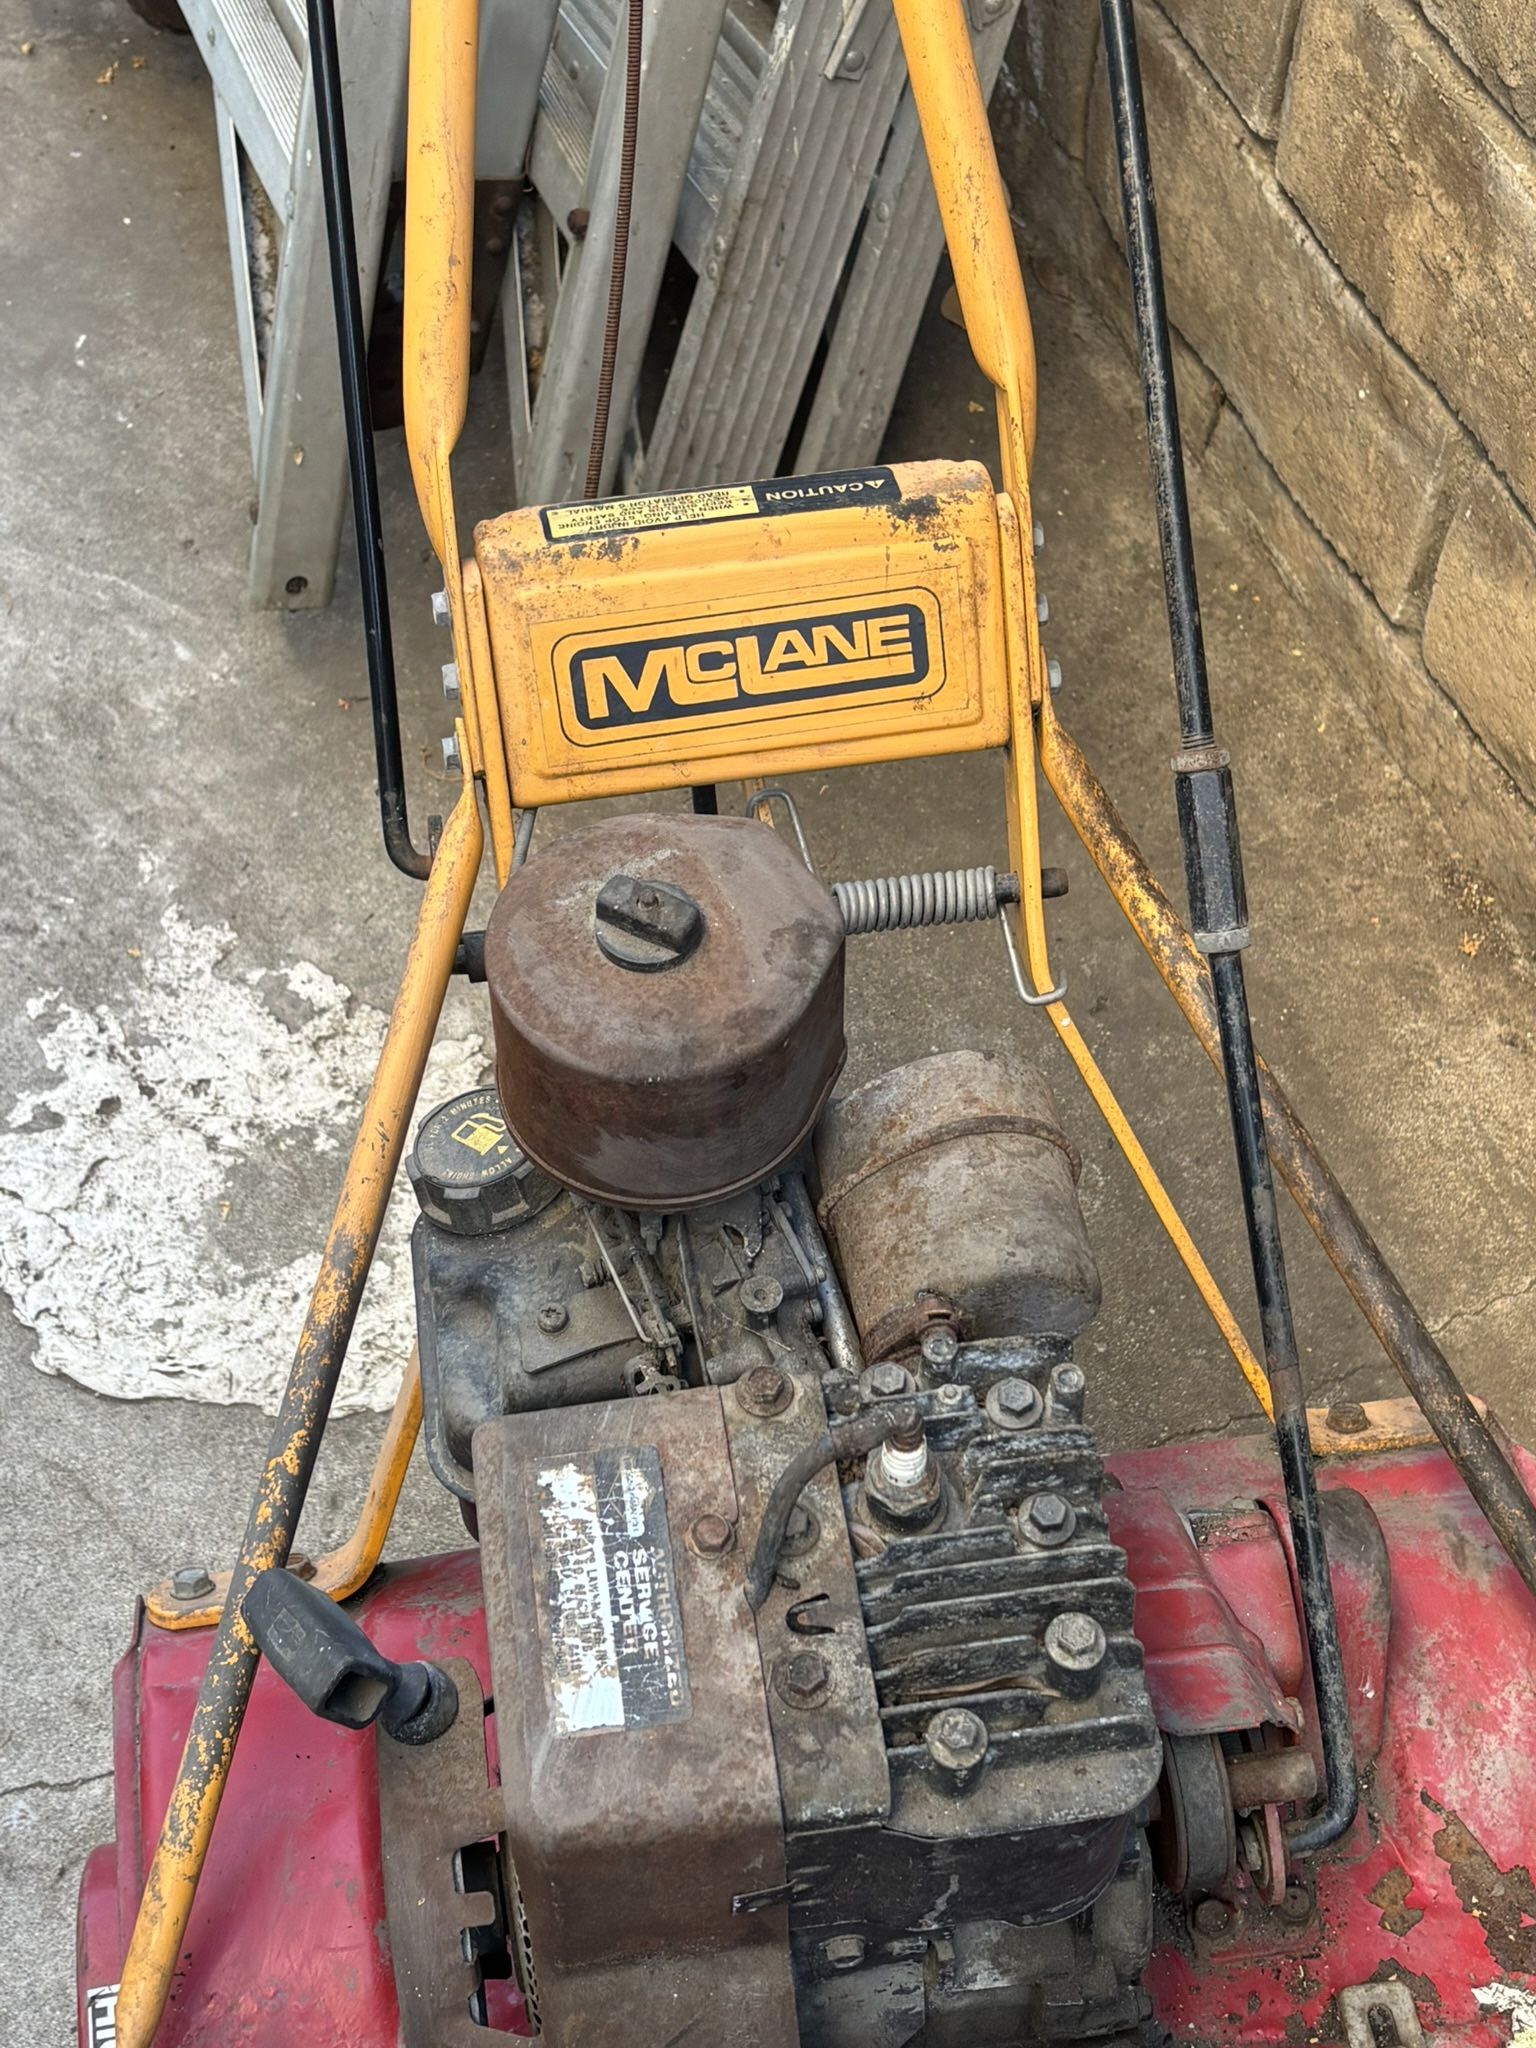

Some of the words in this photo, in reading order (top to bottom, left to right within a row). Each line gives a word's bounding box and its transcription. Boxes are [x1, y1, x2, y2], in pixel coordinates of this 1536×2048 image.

[697, 490, 728, 498] READ
[765, 481, 864, 502] CAUTION
[698, 503, 733, 511] WHEN
[571, 512, 614, 522] SAFETY
[604, 515, 635, 523] STOP
[633, 516, 669, 525] AVOID
[674, 512, 704, 520] HELP
[557, 519, 600, 529] ENGINE
[587, 521, 629, 531] INJURY
[581, 613, 915, 720] MCLANE
[448, 1095, 492, 1117] MINUTES
[480, 1156, 514, 1179] ALLOW
[612, 1550, 640, 1653] CENTER
[630, 1547, 660, 1659] SERVICE
[649, 1545, 684, 1706] AUTHORIZED
